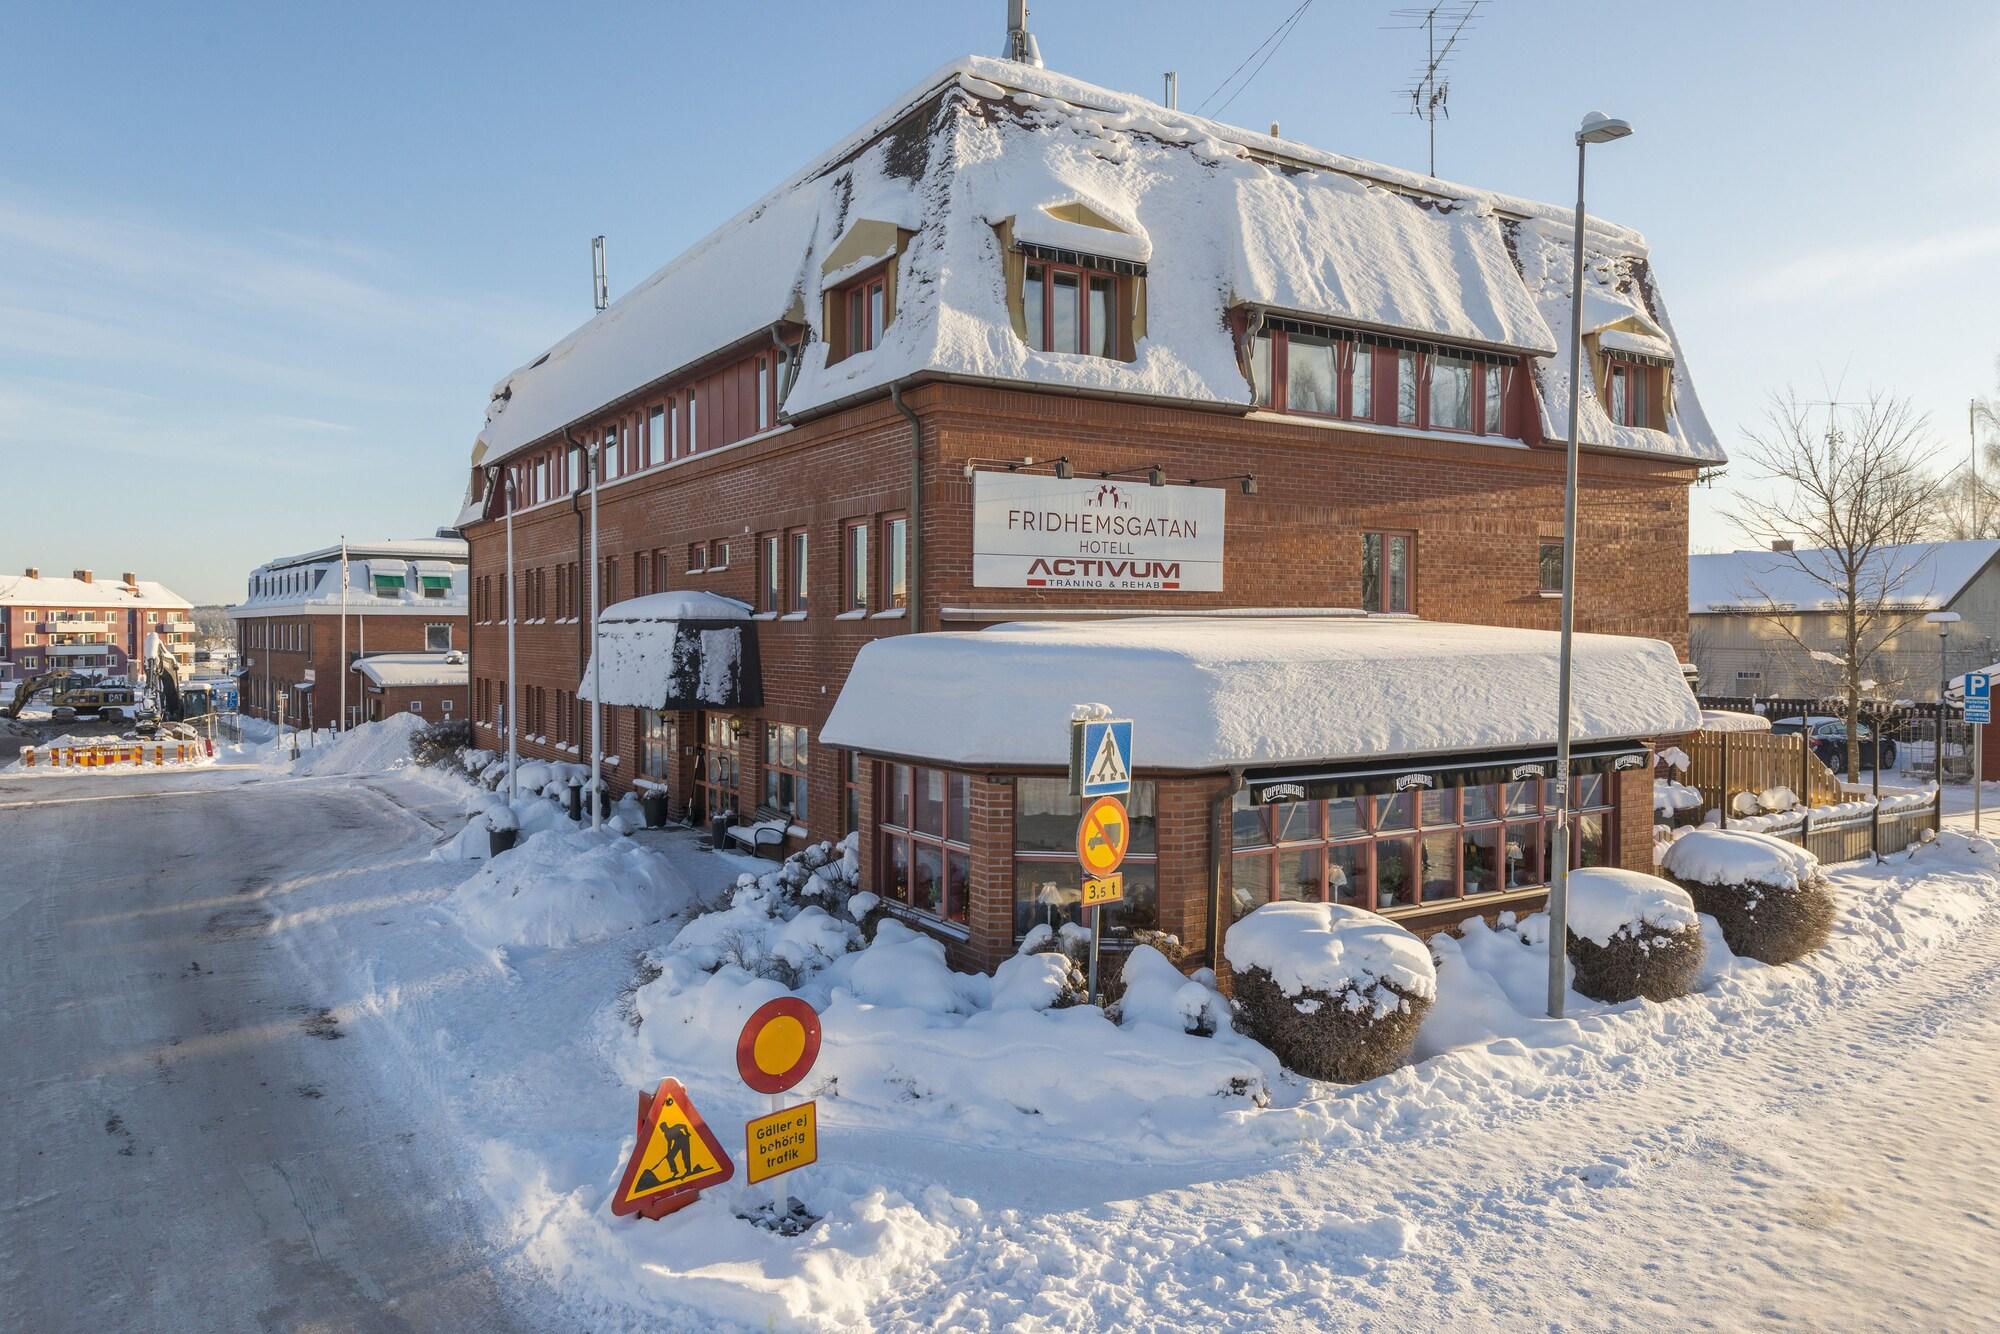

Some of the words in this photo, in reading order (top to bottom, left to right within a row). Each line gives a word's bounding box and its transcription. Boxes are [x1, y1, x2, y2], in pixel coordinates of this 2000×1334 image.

[1008, 510, 1197, 538] FRIDHEMSGATAN
[1080, 540, 1134, 555] HOTELL
[1027, 558, 1180, 579] ACTIVUM
[1048, 579, 1103, 588] TRÄNING
[1122, 581, 1160, 589] REHAB
[1971, 676, 1985, 695] P
[108, 693, 124, 702] CAT
[1512, 764, 1545, 780] KOPPARBERG
[1396, 773, 1433, 791] KOPPARBERG
[1262, 783, 1304, 802] KOPPARBERG
[1112, 881, 1116, 895] t
[757, 1121, 792, 1140] Gäller
[796, 1114, 807, 1127] ej
[760, 1132, 805, 1155] behörig
[767, 1149, 799, 1168] trafik
